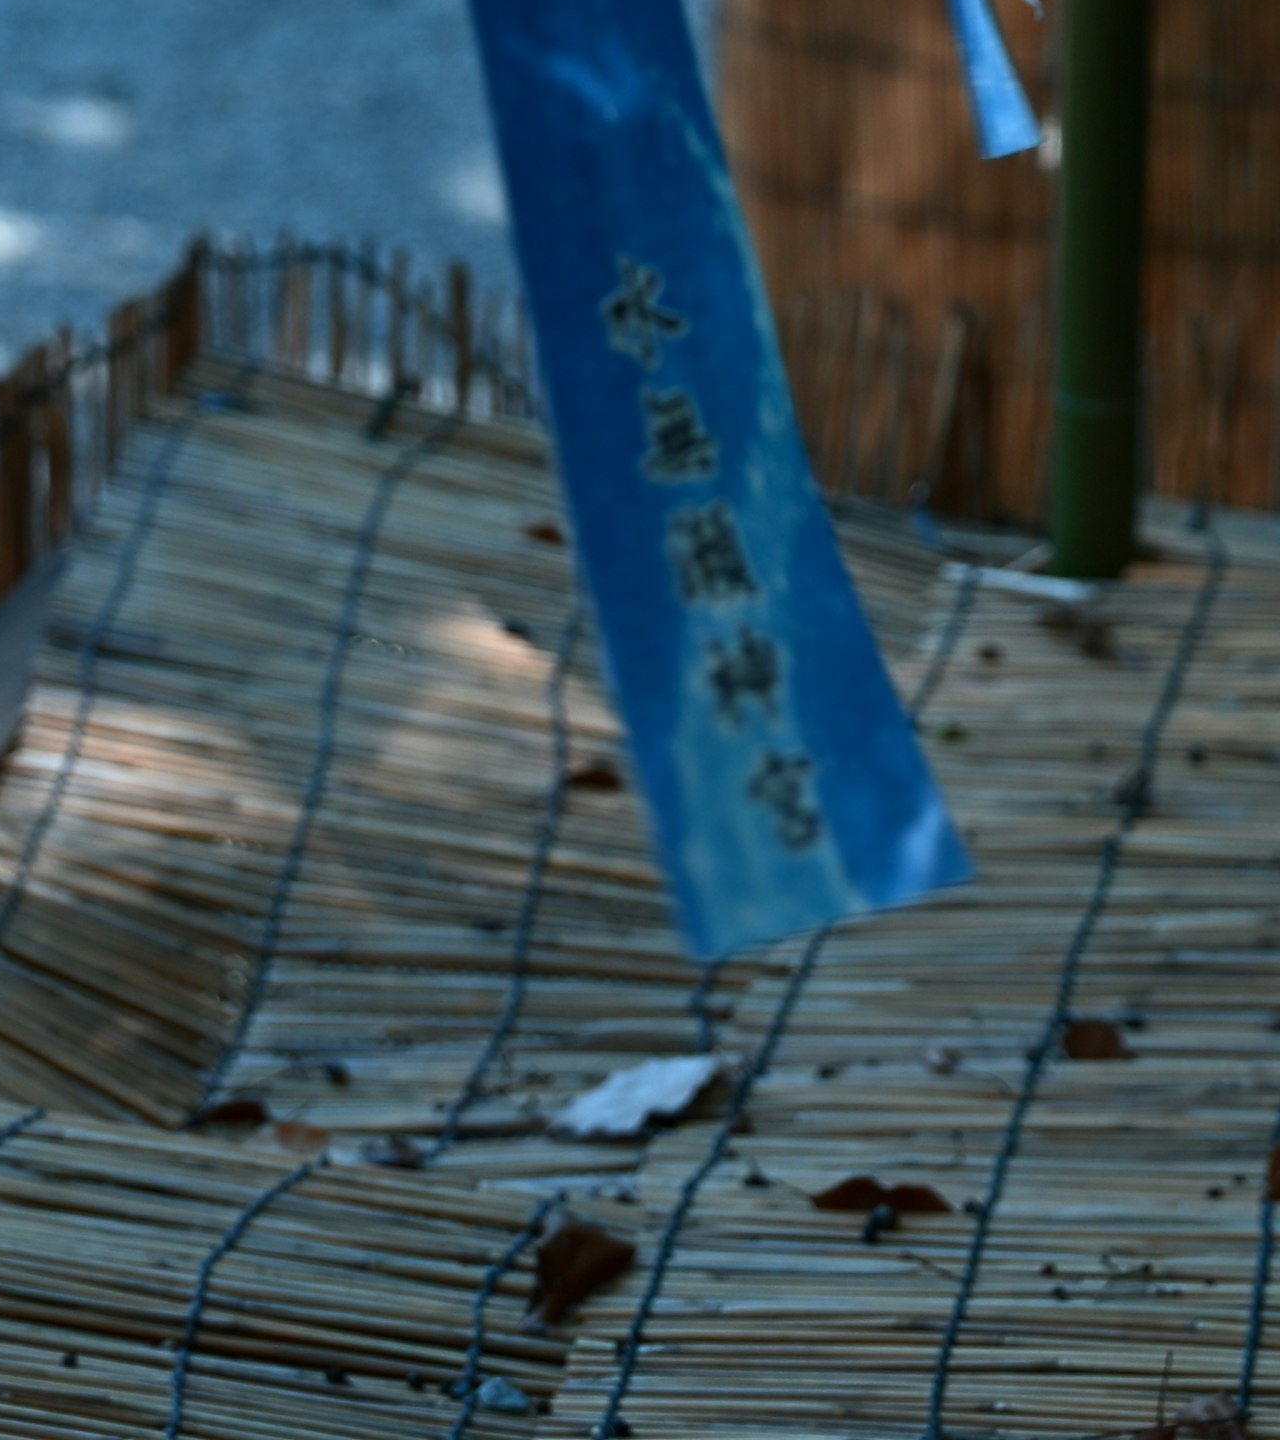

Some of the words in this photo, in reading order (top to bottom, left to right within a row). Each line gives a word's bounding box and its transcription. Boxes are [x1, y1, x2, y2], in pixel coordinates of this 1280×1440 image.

[602, 255, 820, 850] 水無瀬神宮
